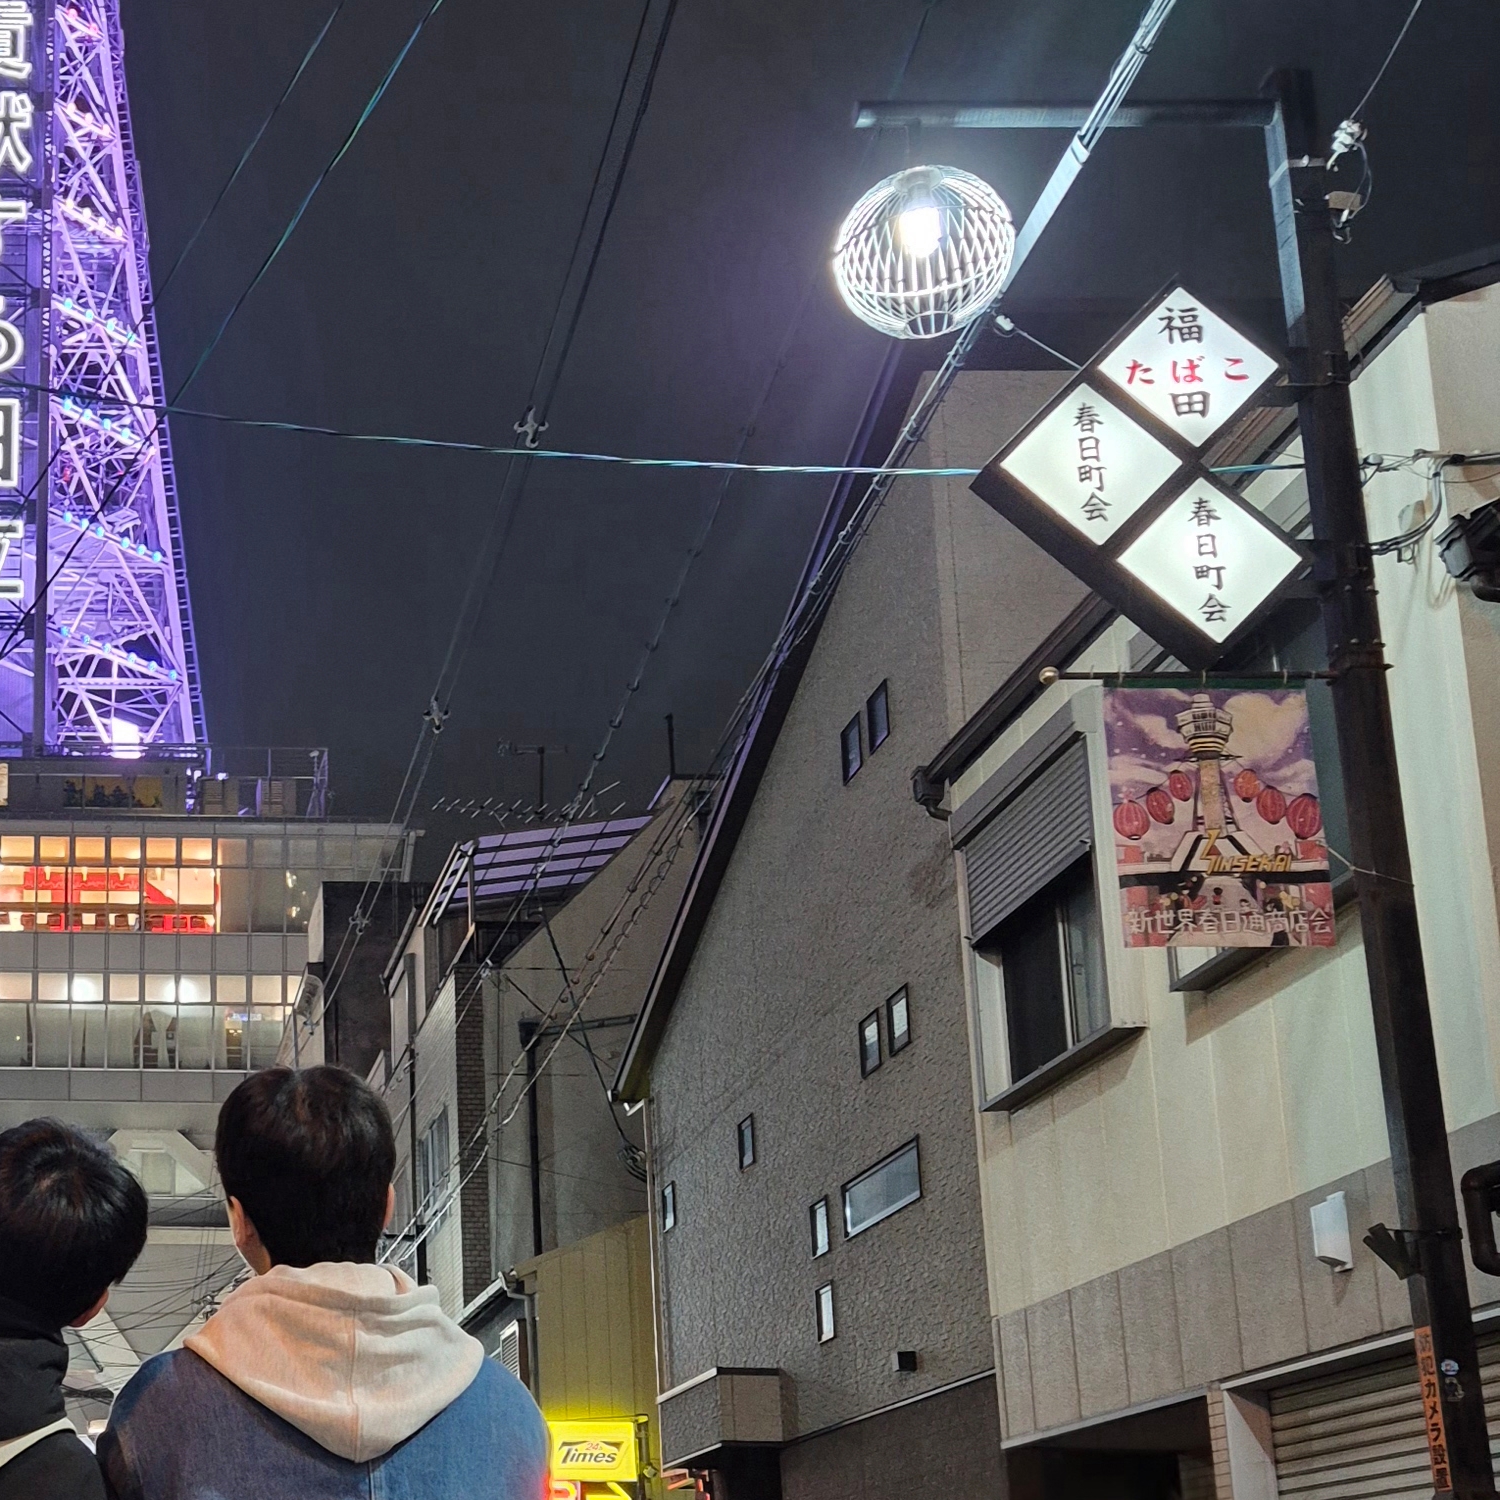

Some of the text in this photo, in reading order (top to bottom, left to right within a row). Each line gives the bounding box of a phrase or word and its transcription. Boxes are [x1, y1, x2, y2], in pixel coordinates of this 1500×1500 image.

[1125, 356, 1250, 386] たばこ
[1072, 402, 1113, 523] 春日町会
[1187, 497, 1232, 623] 春日町会
[560, 1445, 618, 1464] Times
[1415, 1332, 1450, 1490] 防犯カメラ設置
